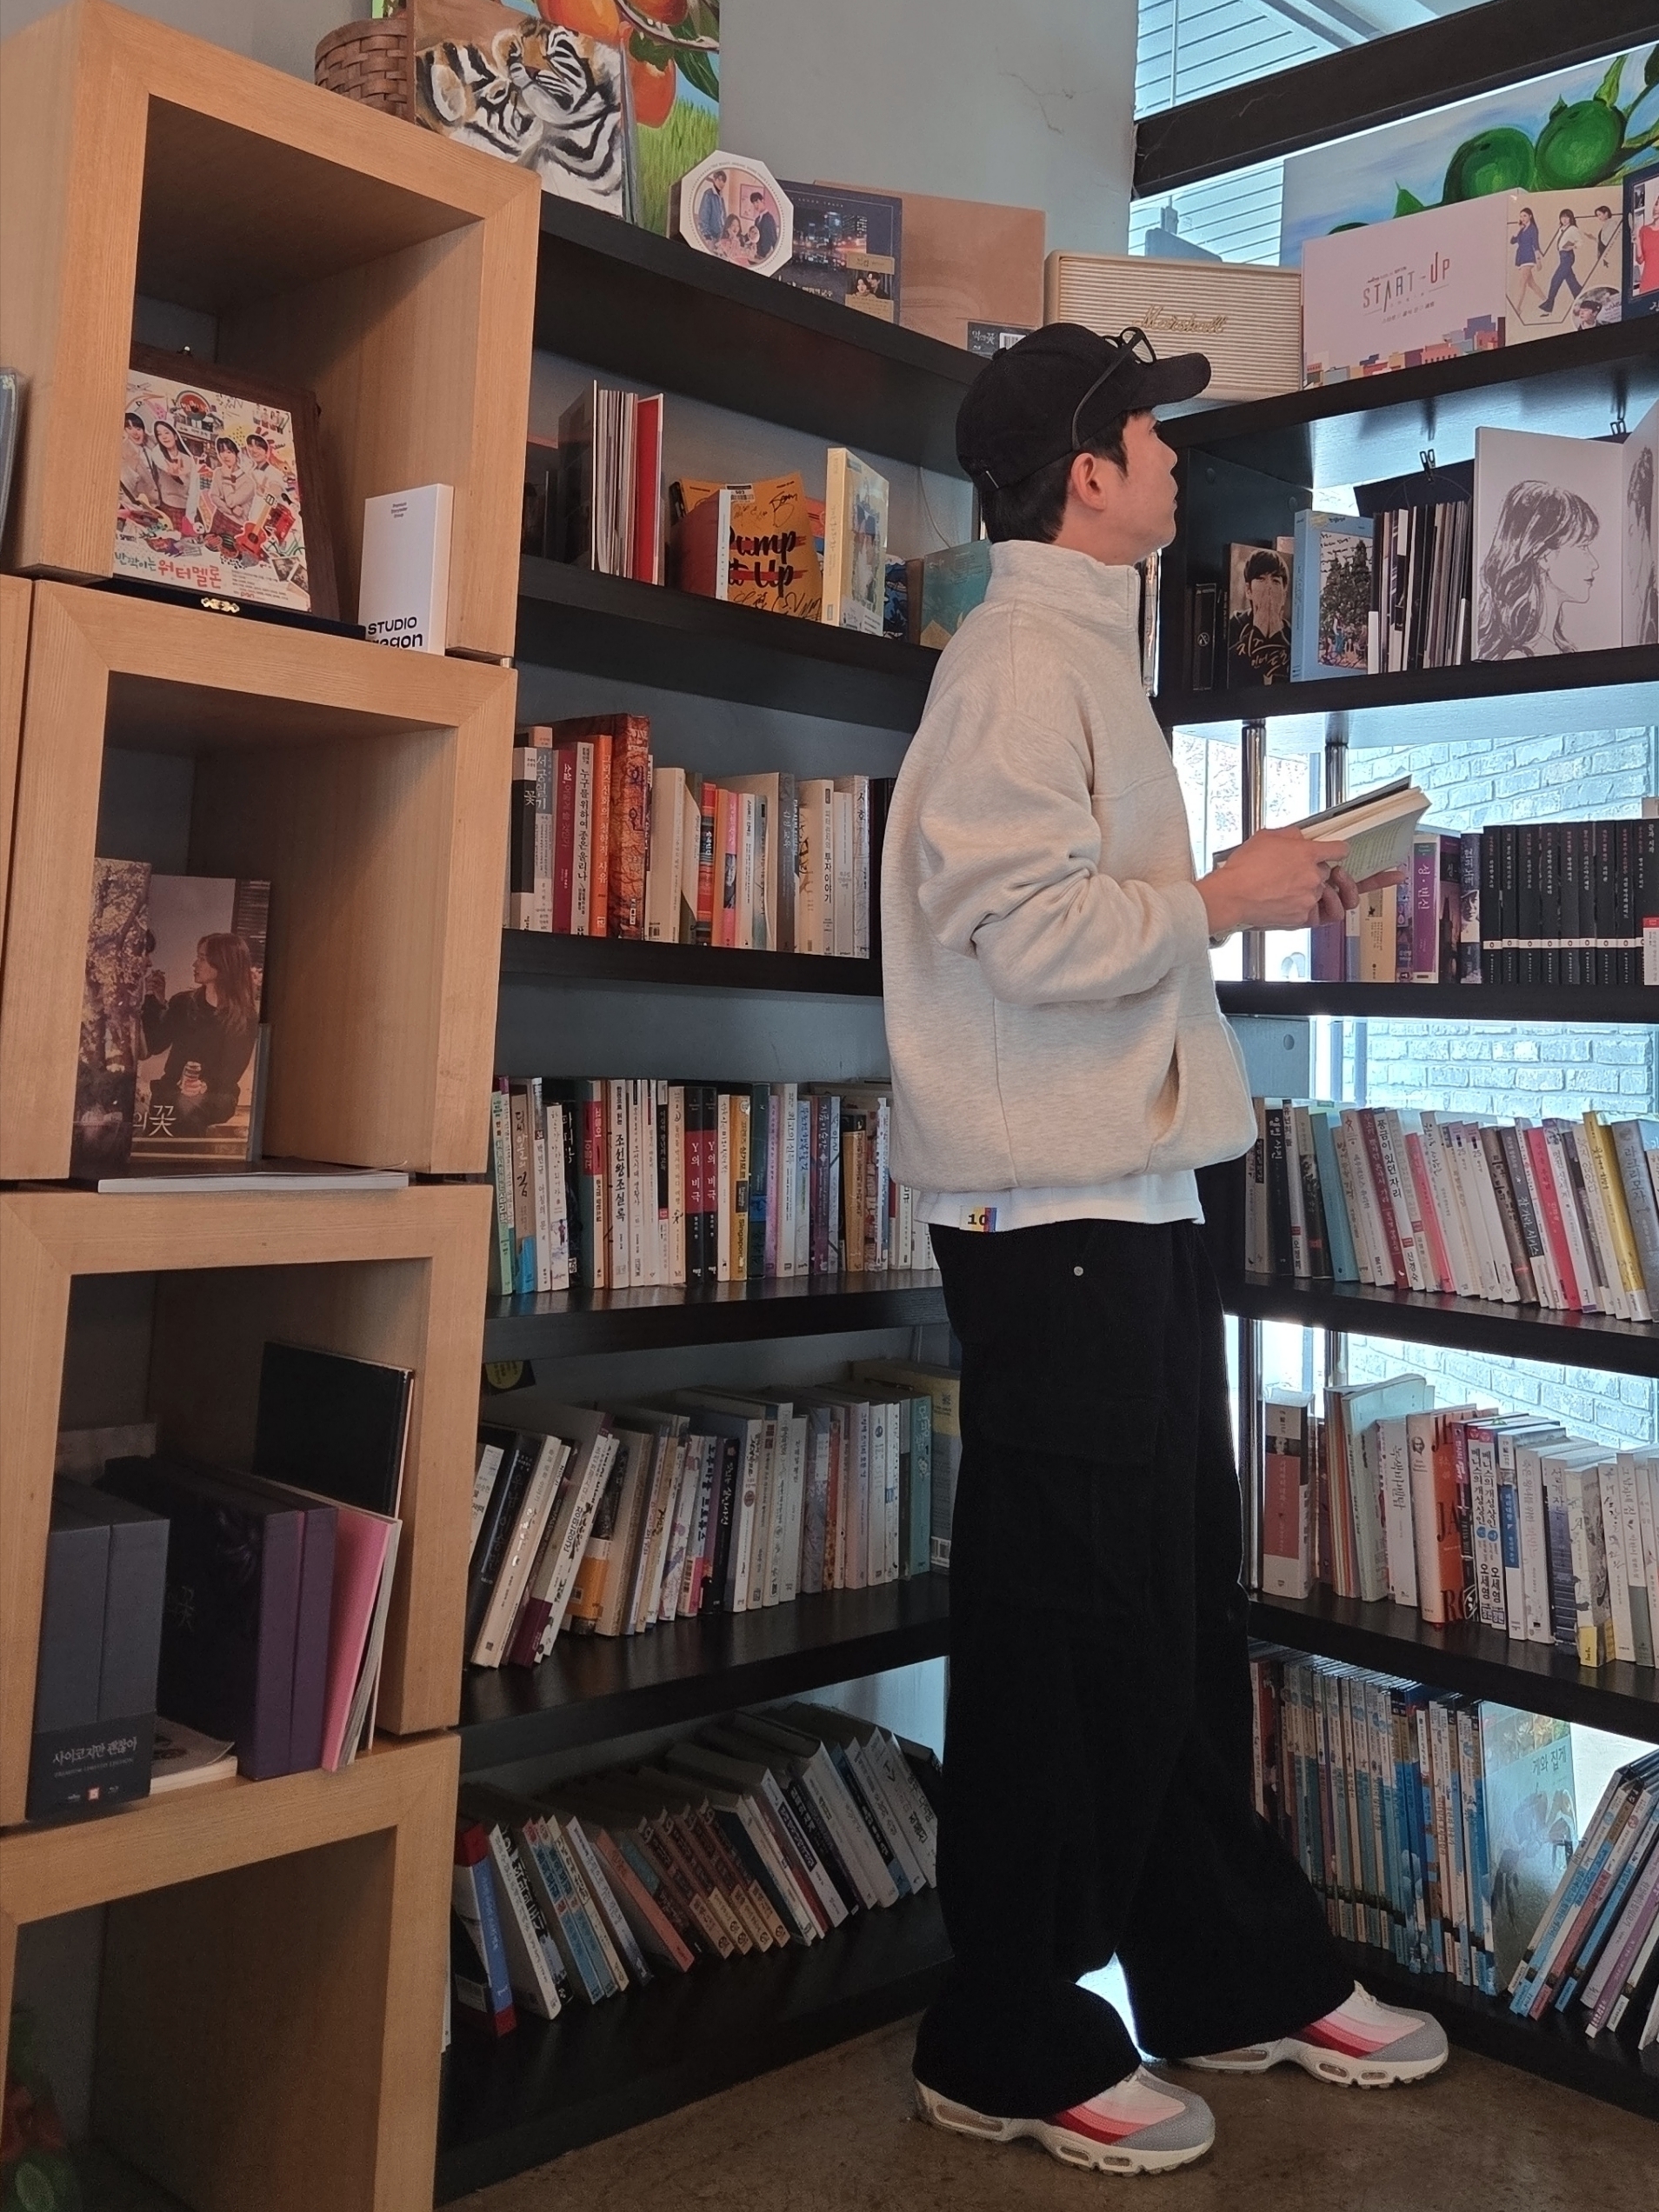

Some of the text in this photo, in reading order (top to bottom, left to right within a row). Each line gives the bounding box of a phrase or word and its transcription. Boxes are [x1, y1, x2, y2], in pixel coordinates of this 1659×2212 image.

[1132, 304, 1228, 334] Marshall
[114, 551, 157, 572] 반짝이는
[157, 559, 222, 590] 워터멜론
[754, 559, 795, 598] Up
[367, 616, 417, 636] STUDIO
[536, 754, 553, 810] 서궁일기
[563, 763, 573, 783] 소설,
[523, 790, 536, 806] 꽃
[576, 769, 591, 881] 누구를 위하여 종은 울리나
[597, 862, 608, 883] 사유
[824, 853, 832, 872] 투자
[823, 873, 832, 904] 이야기
[149, 1104, 177, 1137] 꽃
[819, 1104, 829, 1149] 지금 이 순간
[1283, 1107, 1292, 1135] 유년의
[1271, 1139, 1283, 1160] 사진
[1376, 1119, 1402, 1199] 풍금이 있던 자리
[1472, 1149, 1482, 1158] 25
[616, 1133, 626, 1222] 조선왕조실록
[691, 1143, 701, 1202] Y의 비극
[708, 1141, 716, 1201] Y의 비극
[1293, 1240, 1302, 1270] 오정희
[1406, 1252, 1419, 1283] 신경숙
[1470, 1447, 1485, 1525] 베니스의 개성상인
[1622, 1467, 1629, 1476] 그
[1481, 1449, 1496, 1529] 베니스의 개성상인
[1622, 1476, 1636, 1503] 남자네
[1623, 1505, 1636, 1516] 집
[1480, 1562, 1489, 1600] 오세영
[1490, 1566, 1501, 1603] 오세영
[52, 1736, 137, 1766] 사이코지만 괜찮아
[1531, 1749, 1568, 1775] 게와 집게
